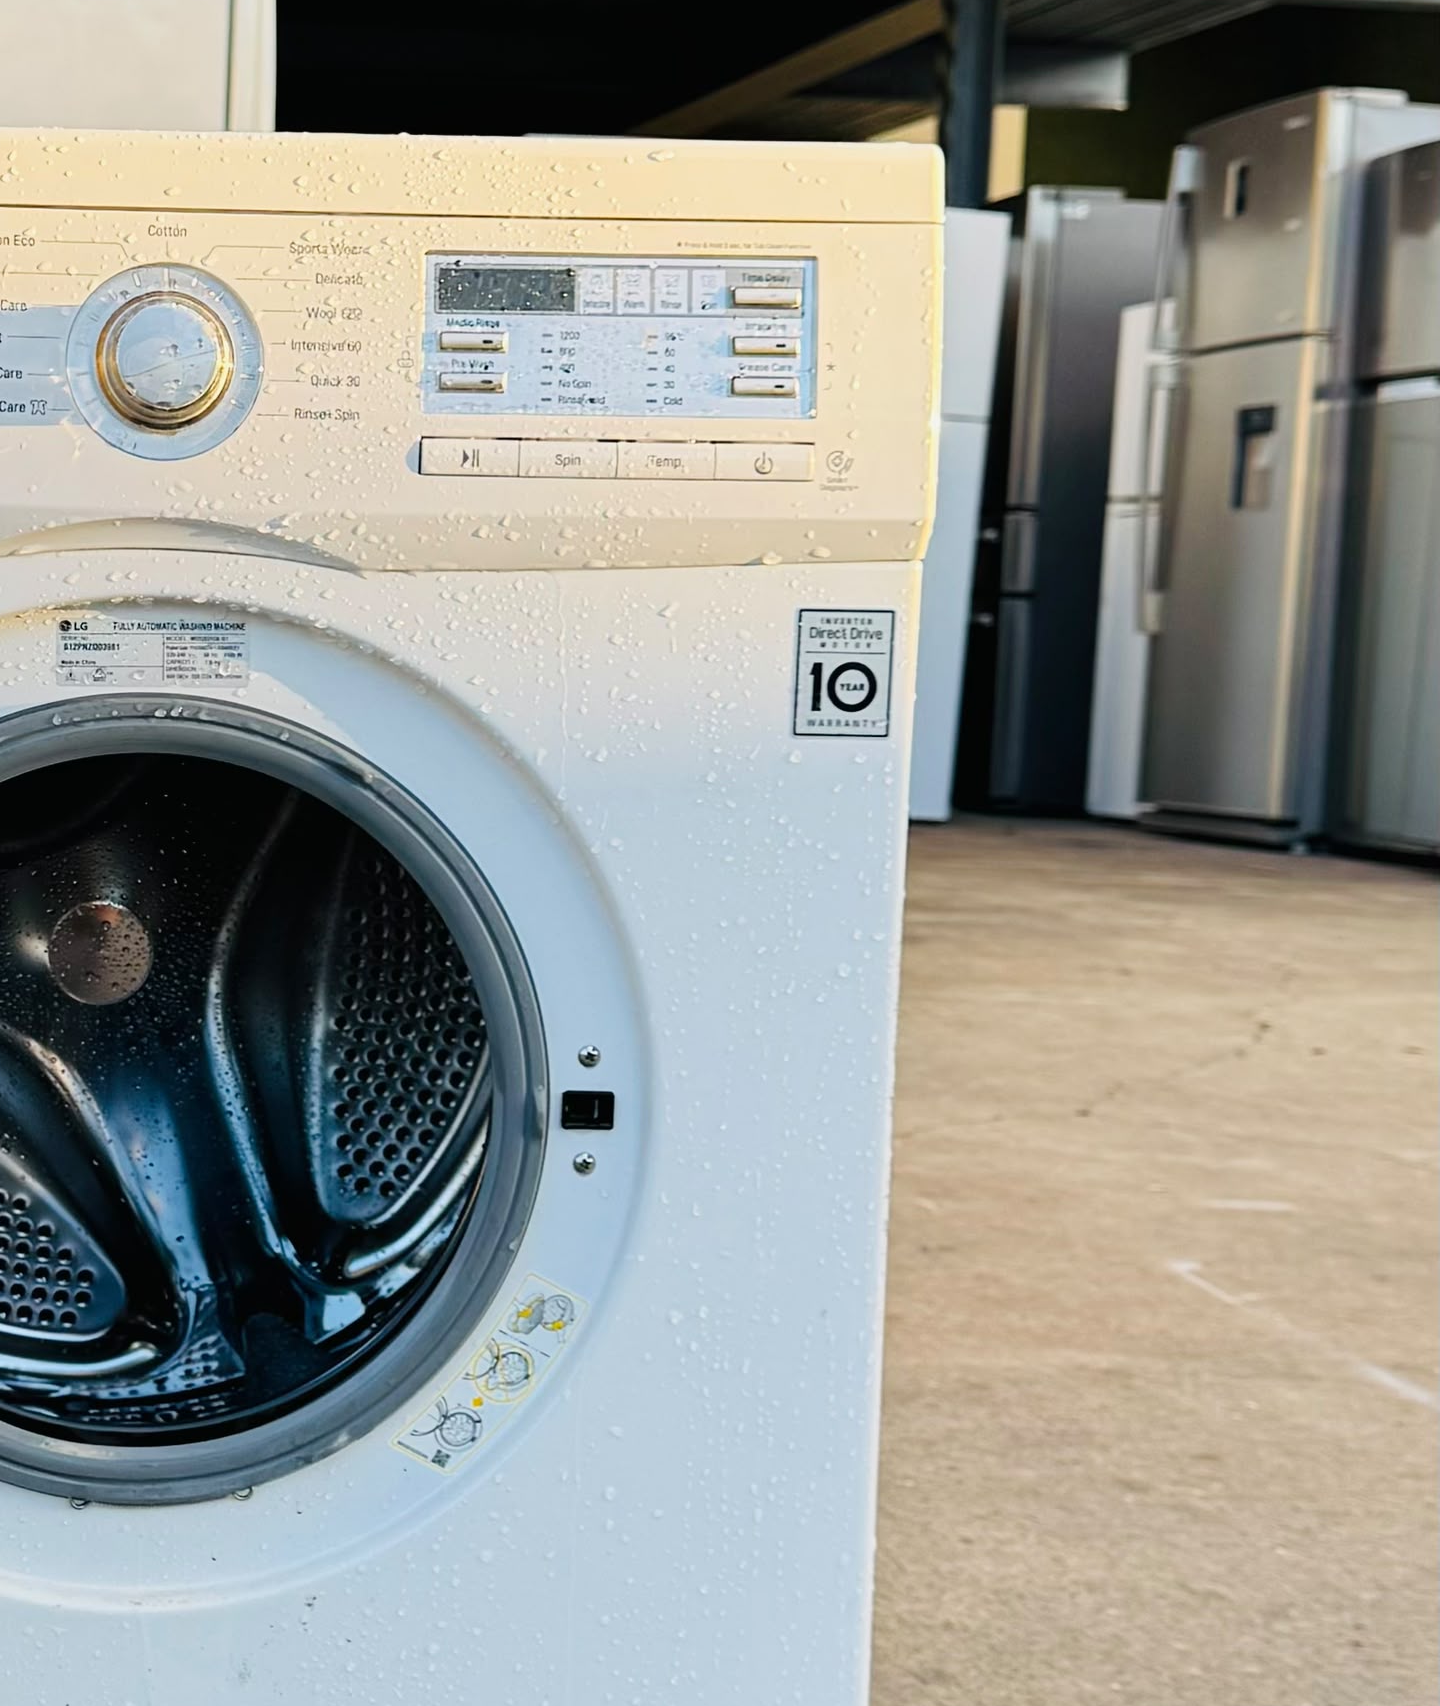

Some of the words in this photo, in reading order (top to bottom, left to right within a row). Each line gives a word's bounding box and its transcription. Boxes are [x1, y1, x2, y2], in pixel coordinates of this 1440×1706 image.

[148, 224, 187, 238] Cotton
[13, 234, 36, 247] Eco
[0, 299, 28, 312] Care
[306, 306, 337, 320] Wool
[310, 374, 343, 388] Quick
[346, 375, 361, 387] 30
[0, 400, 26, 413] Care
[554, 454, 581, 468] Spin
[74, 622, 88, 631] LG
[112, 622, 135, 631] FULLY
[136, 622, 177, 631] AUTOMATIC
[179, 622, 212, 631] WASHING
[214, 622, 246, 631] MACHINE
[820, 617, 873, 626] INVERTER
[809, 627, 847, 640] Direct
[850, 627, 883, 640] Drive
[809, 661, 877, 713] 10
[840, 683, 865, 691] YEAR
[807, 719, 877, 728] WARRANTY
